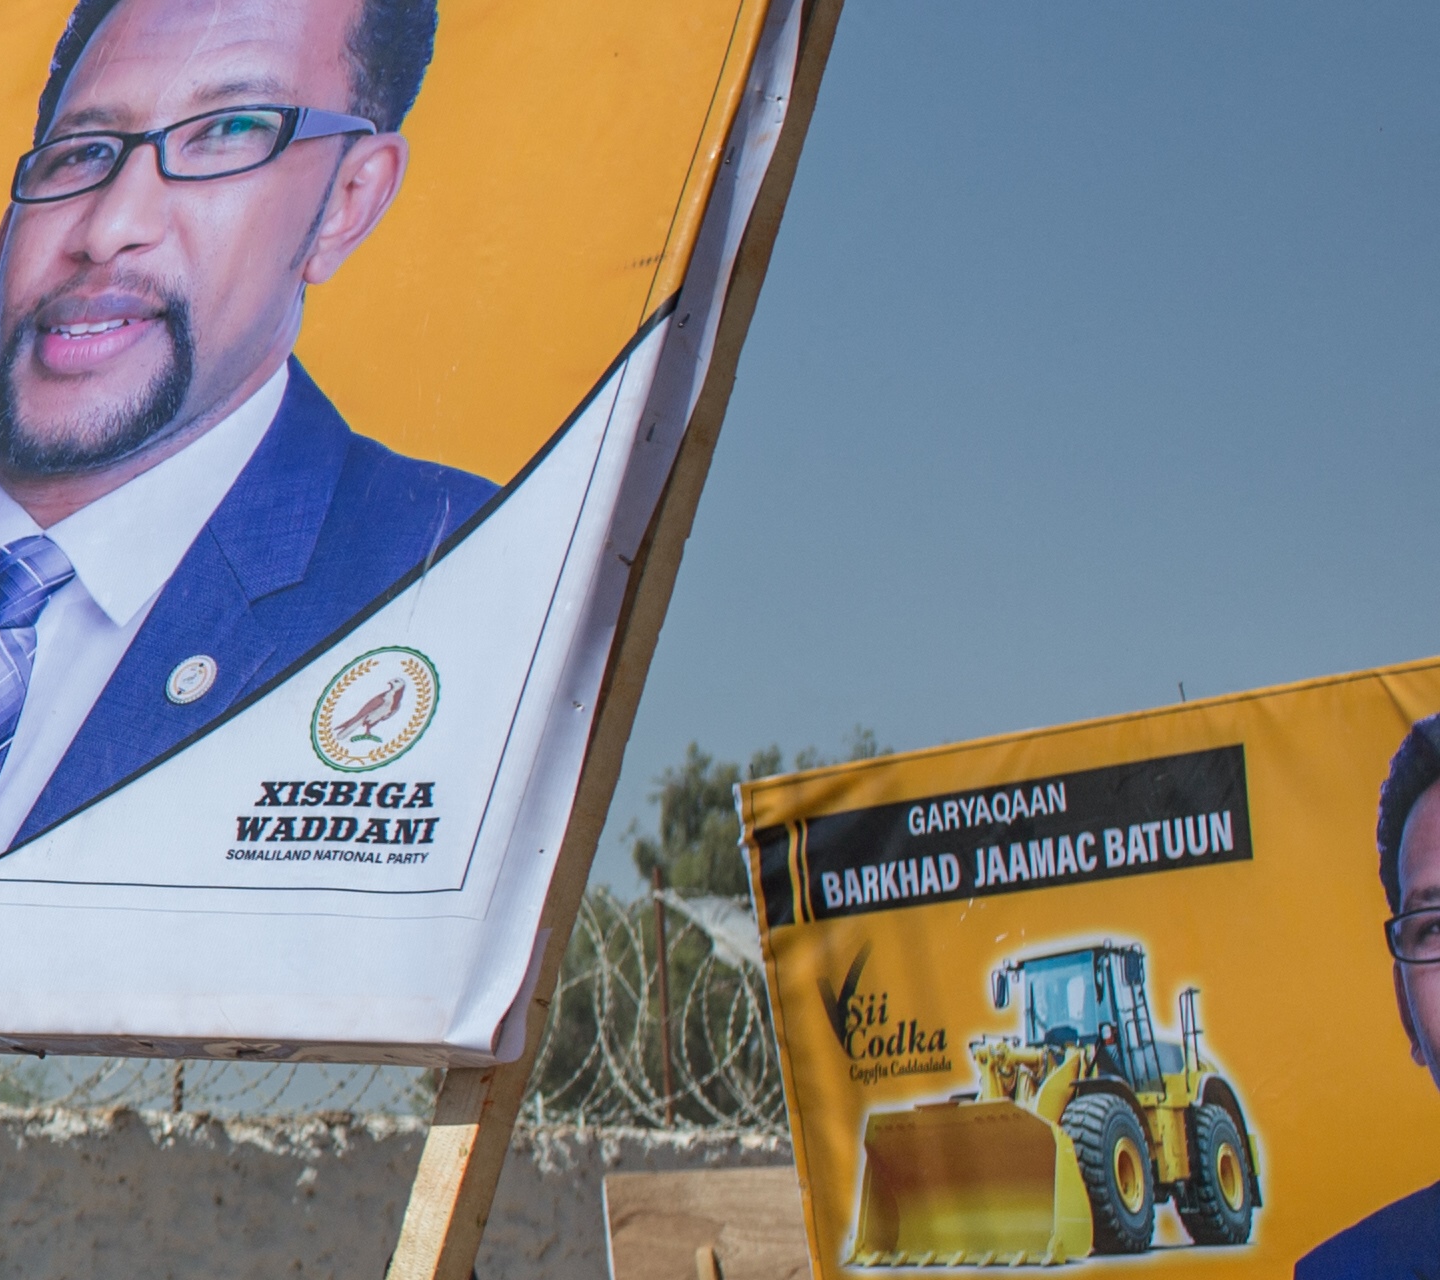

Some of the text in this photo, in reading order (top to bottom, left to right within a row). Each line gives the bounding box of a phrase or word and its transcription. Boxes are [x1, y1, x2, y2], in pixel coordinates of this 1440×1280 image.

[254, 781, 435, 809] XISBIGA
[907, 782, 1067, 837] GARYAQAAN
[235, 816, 440, 845] WADDANI
[225, 849, 429, 864] SOMALILAND NATIONAL PARTY
[822, 810, 1234, 909] BARKHAD JAAMAC BATUUN
[846, 992, 888, 1029] Sii
[846, 1020, 947, 1060] Codka
